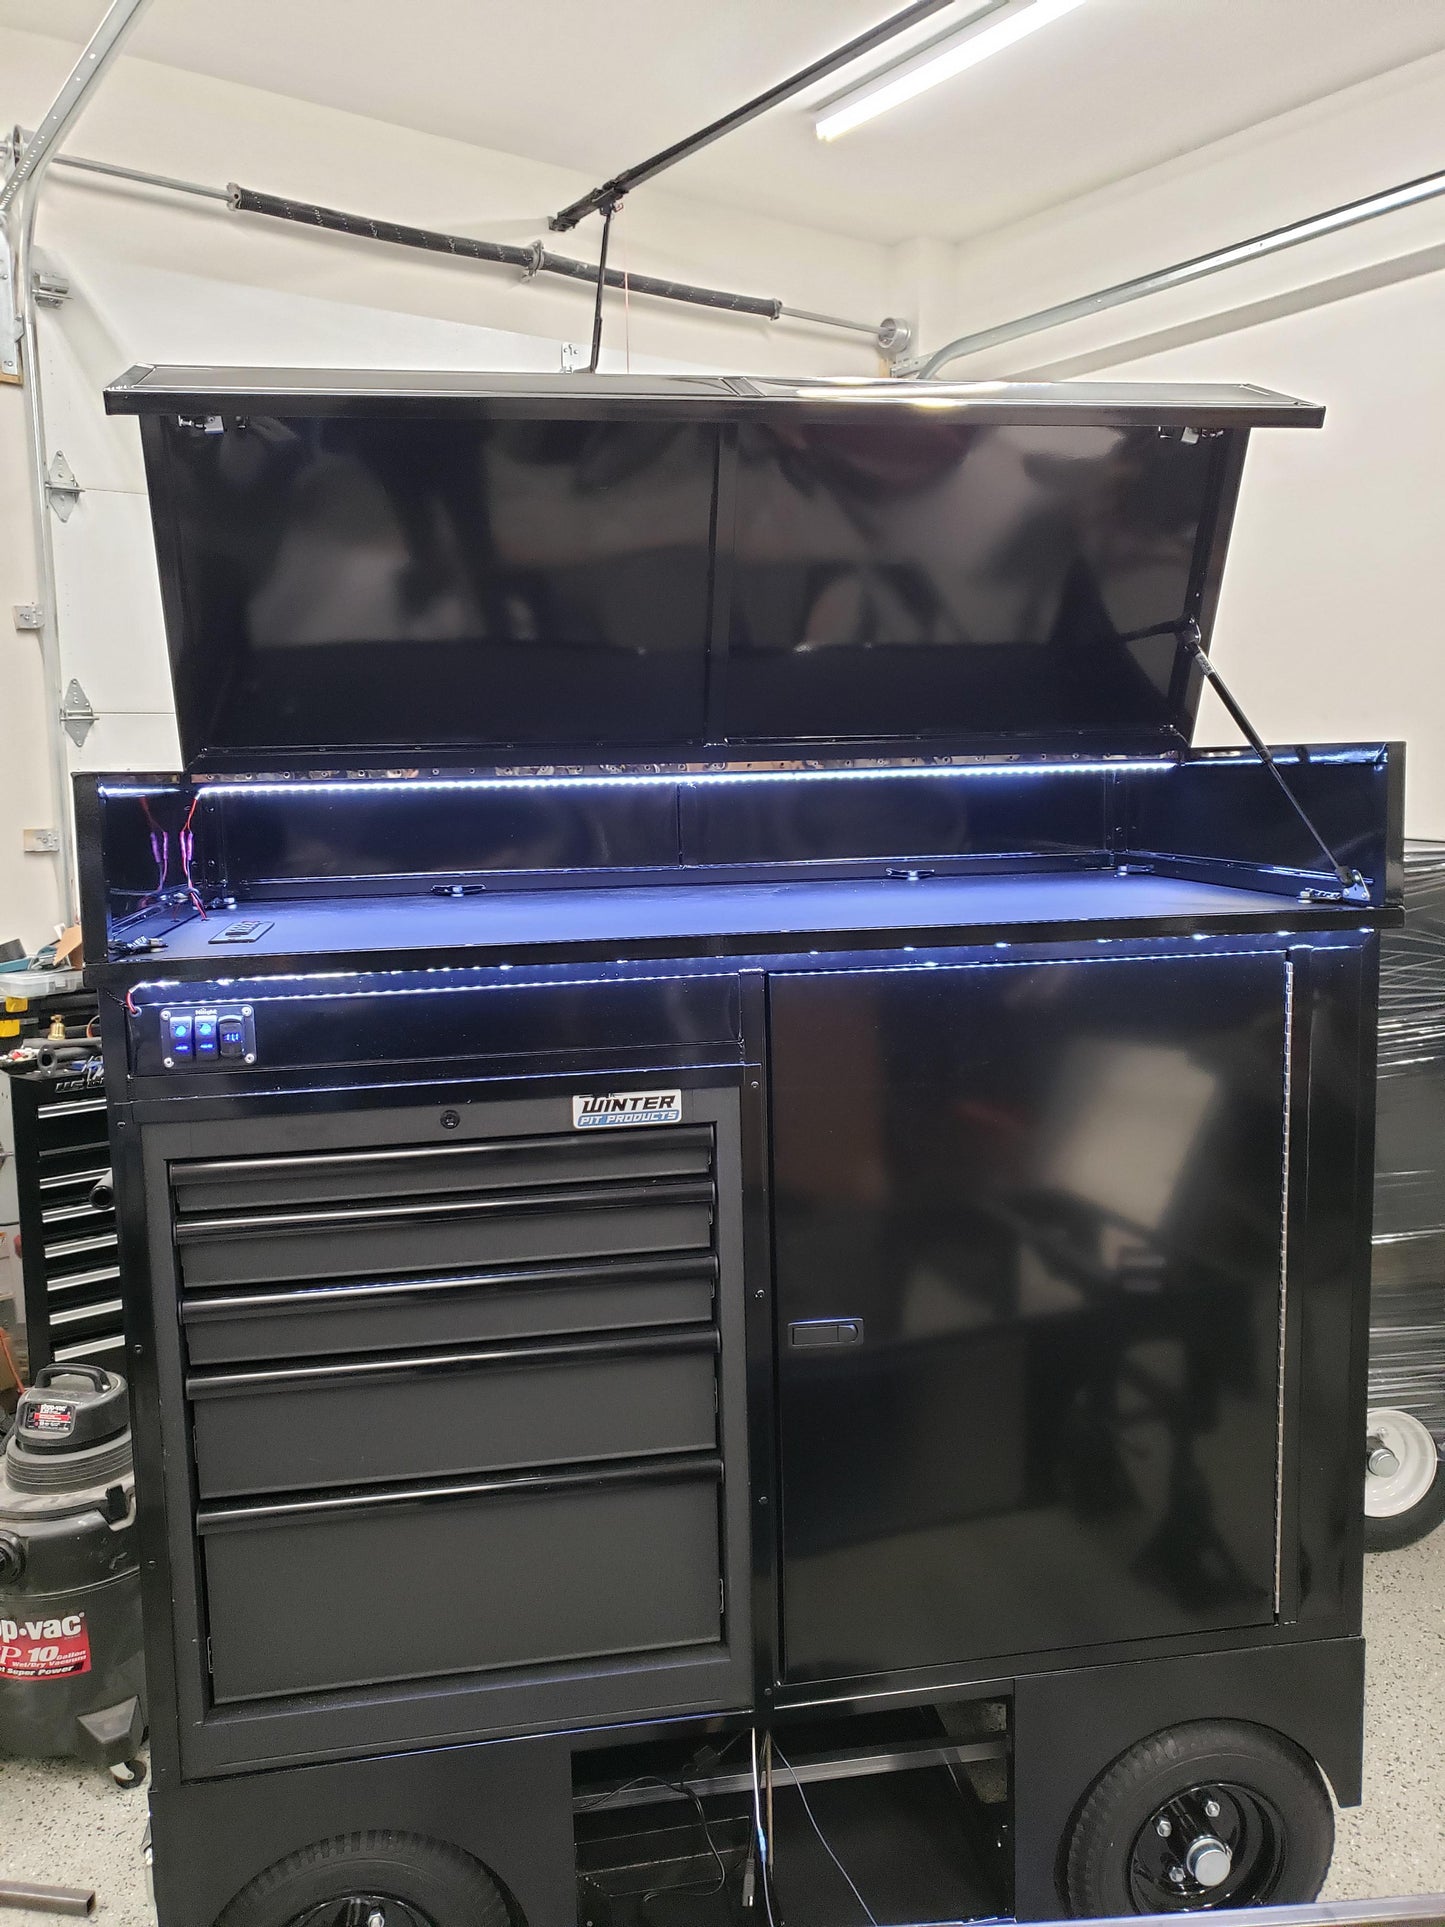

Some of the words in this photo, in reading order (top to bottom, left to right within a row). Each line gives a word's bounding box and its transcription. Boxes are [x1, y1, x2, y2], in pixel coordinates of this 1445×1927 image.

[582, 1095, 676, 1114] WINTER
[580, 1115, 602, 1125] PIT
[606, 1111, 677, 1123] PRODUCTS
[0, 1646, 22, 1665] P
[28, 1646, 59, 1663] 10
[56, 1650, 86, 1661] Gallon
[49, 1655, 87, 1665] Vacuum
[7, 1667, 36, 1676] Super
[37, 1665, 75, 1675] Power
